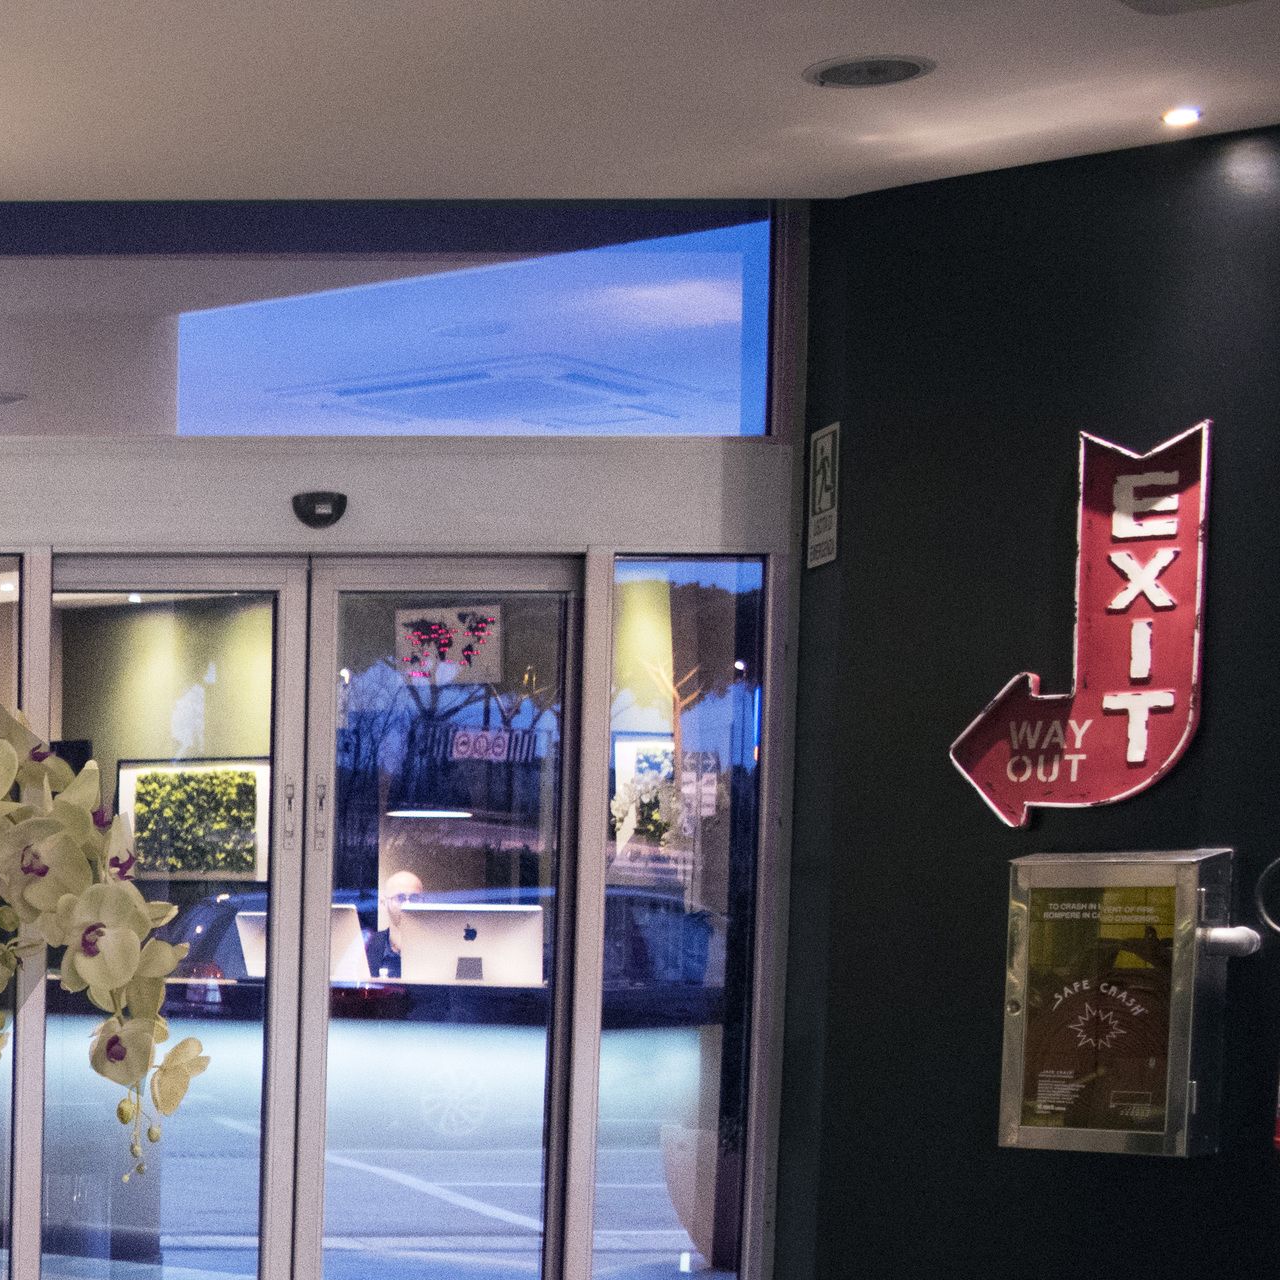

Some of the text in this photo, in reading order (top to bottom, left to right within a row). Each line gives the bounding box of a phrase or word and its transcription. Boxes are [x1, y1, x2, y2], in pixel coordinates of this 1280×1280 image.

[1102, 471, 1181, 763] EXIT
[1008, 719, 1094, 750] WAY
[1006, 754, 1087, 783] OUT
[1098, 903, 1122, 914] VENT
[1052, 979, 1145, 1017] SAFE CRASH
